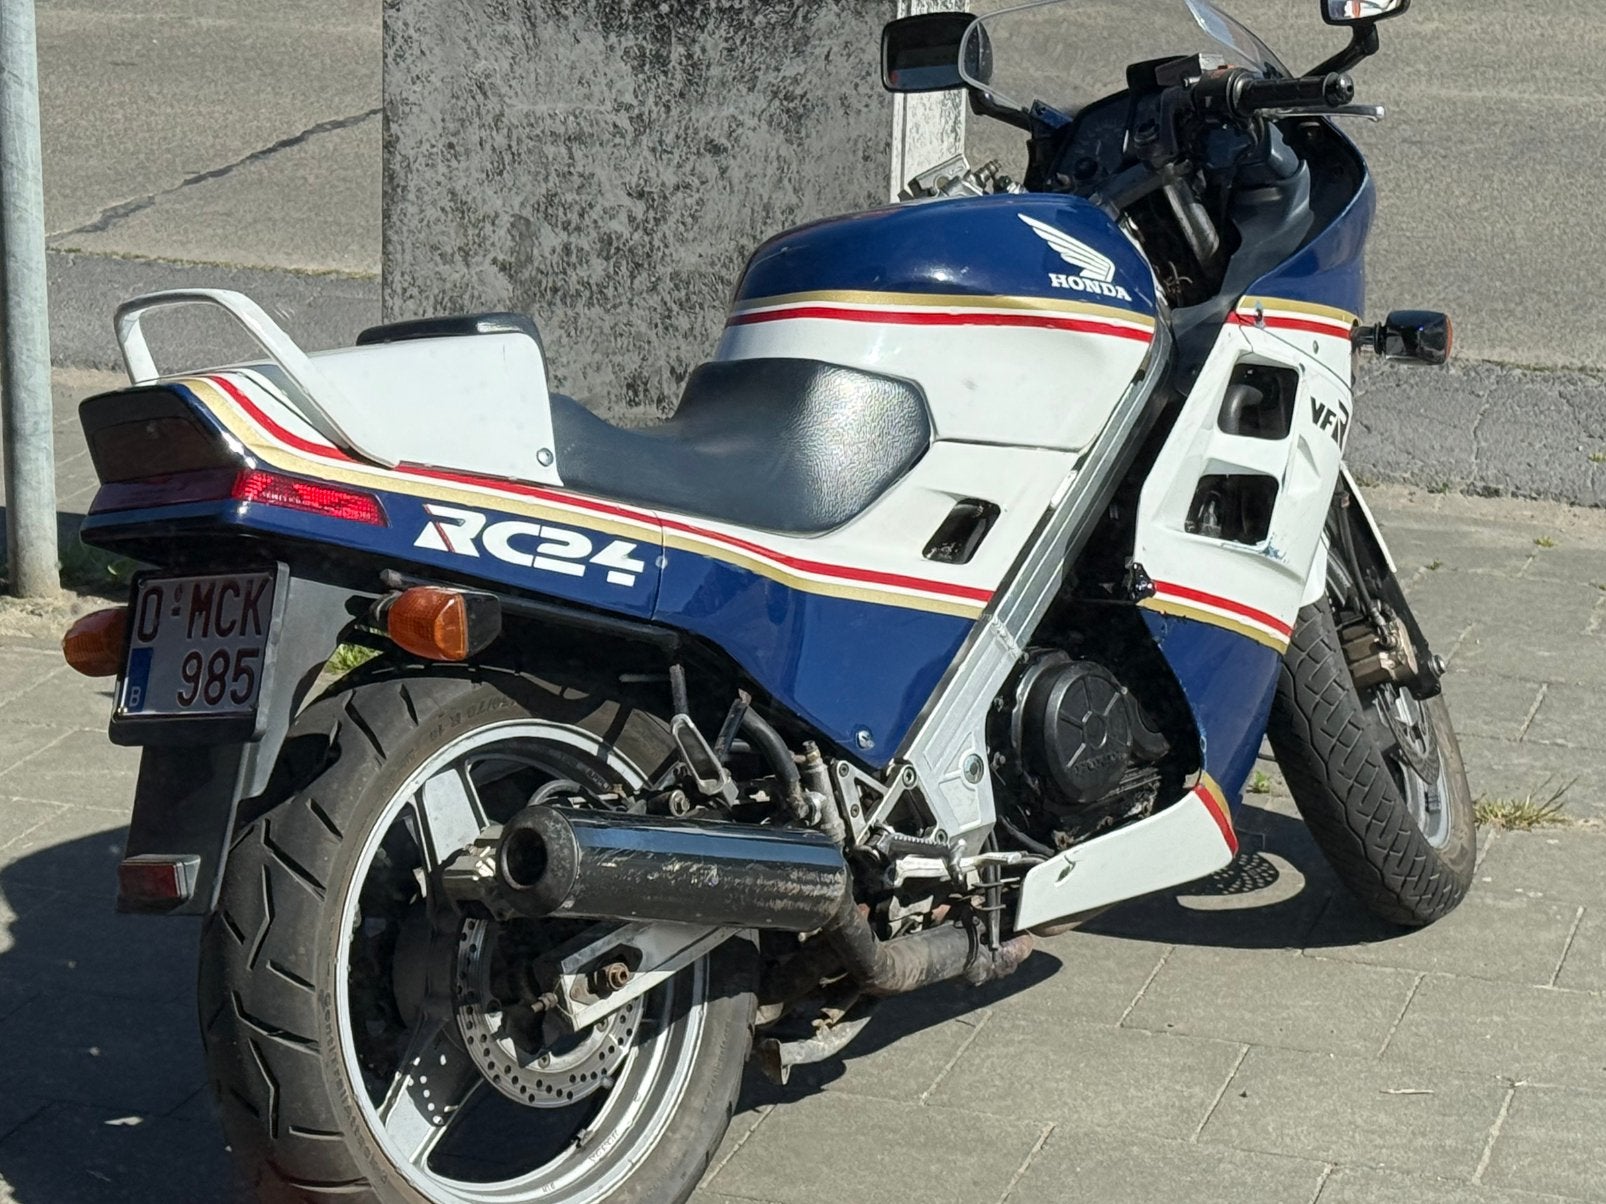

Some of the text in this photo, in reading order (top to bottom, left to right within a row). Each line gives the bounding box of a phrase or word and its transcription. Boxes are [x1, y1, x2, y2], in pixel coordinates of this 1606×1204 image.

[1048, 273, 1132, 301] HONDA
[413, 503, 645, 587] RC24
[130, 685, 141, 706] B
[176, 647, 260, 707] 985
